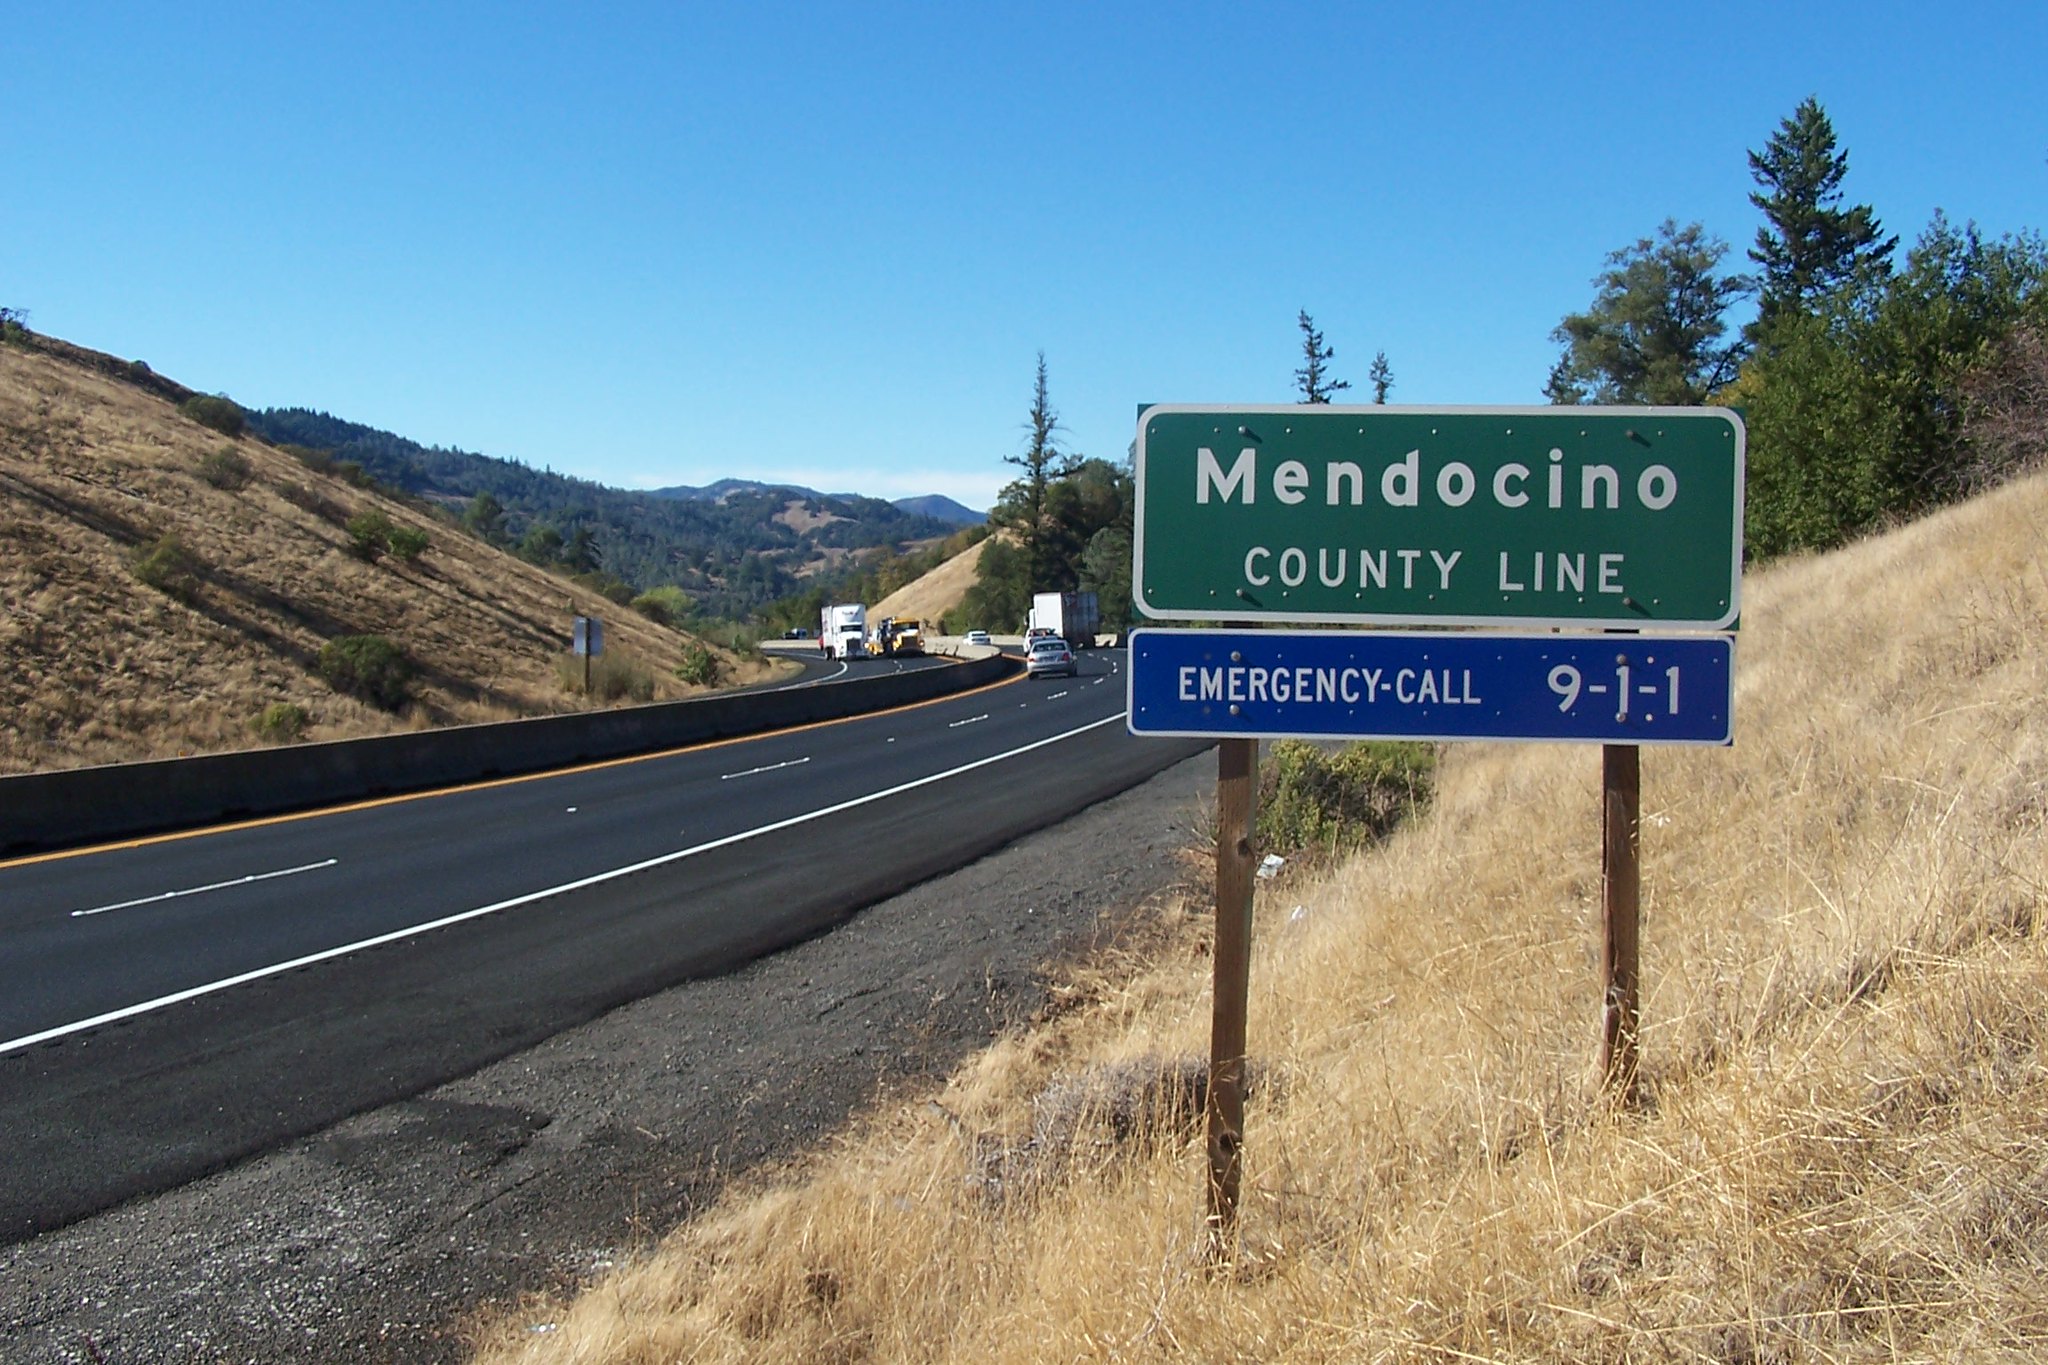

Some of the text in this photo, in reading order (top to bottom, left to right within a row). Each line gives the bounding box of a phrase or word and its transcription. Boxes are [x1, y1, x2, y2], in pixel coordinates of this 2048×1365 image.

[1195, 447, 1678, 511] Mendocino
[1244, 546, 1626, 594] COUNTY LINE
[1178, 664, 1679, 716] EMERGENCY-CALL 9-1-1
